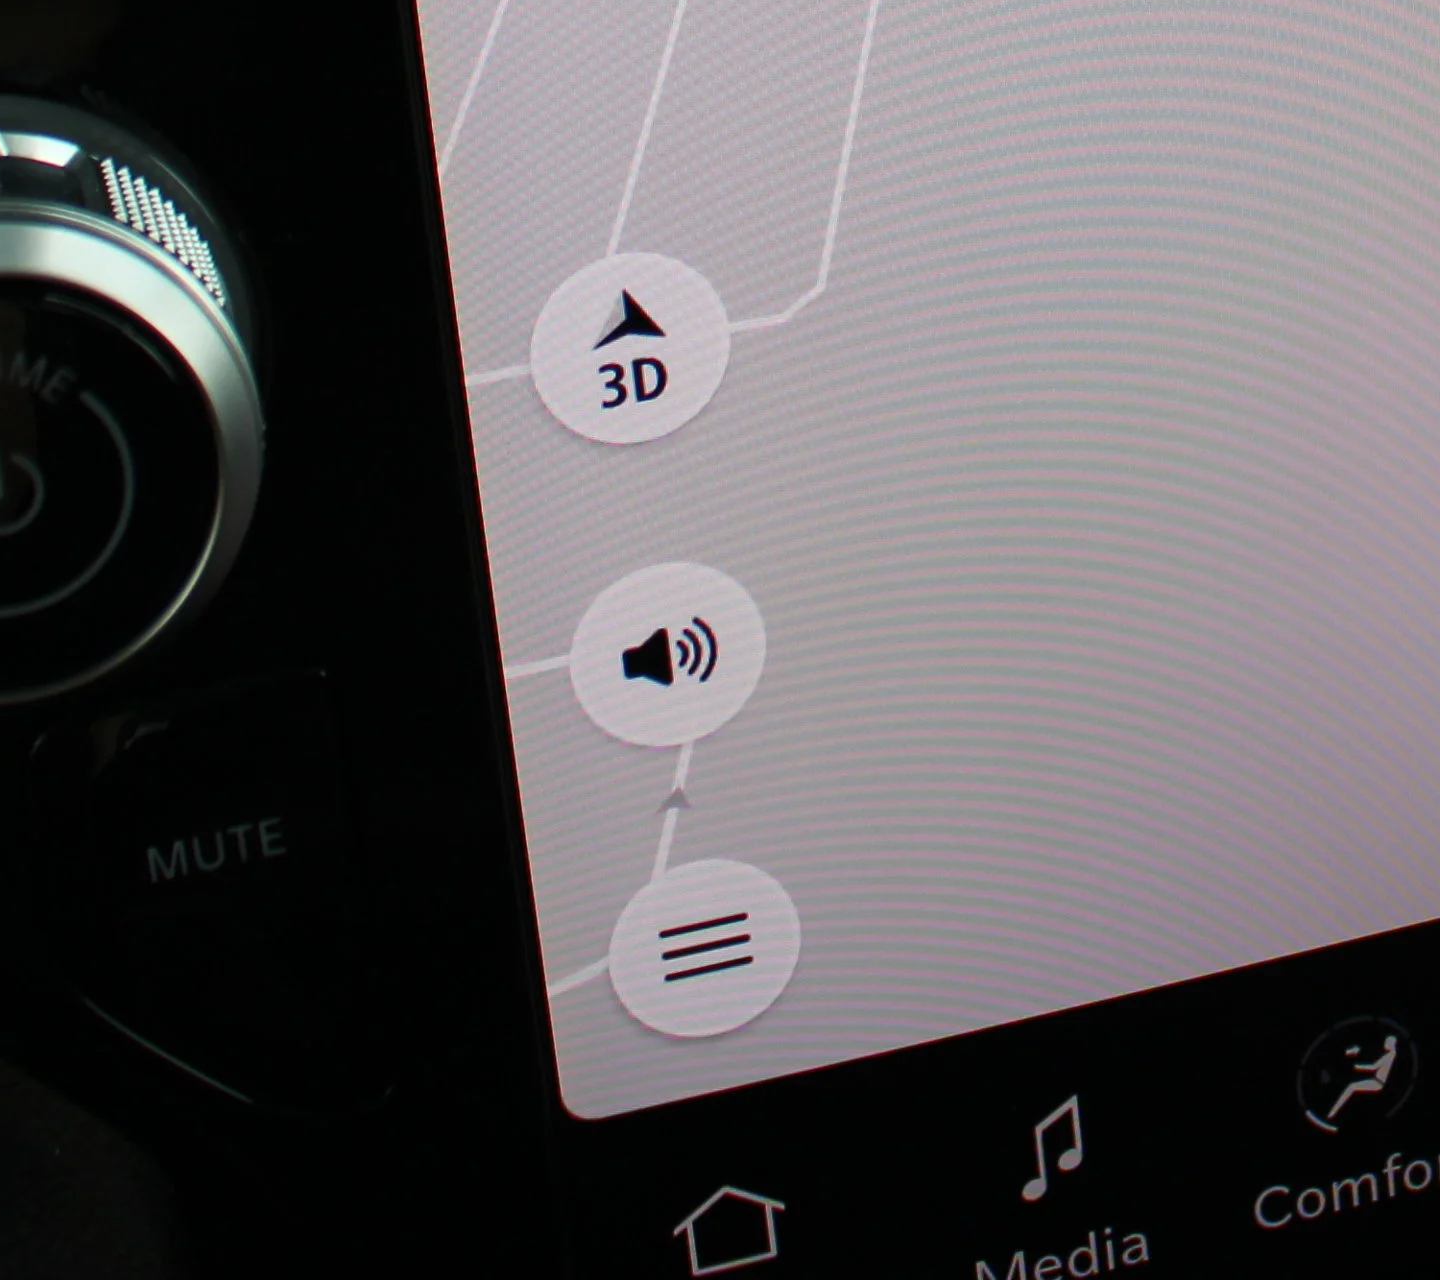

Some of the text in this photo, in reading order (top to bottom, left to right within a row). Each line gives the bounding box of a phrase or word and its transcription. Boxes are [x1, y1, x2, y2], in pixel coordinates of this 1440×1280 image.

[599, 357, 668, 408] 3D
[146, 816, 288, 884] MUTE
[974, 1226, 1150, 1280] Media
